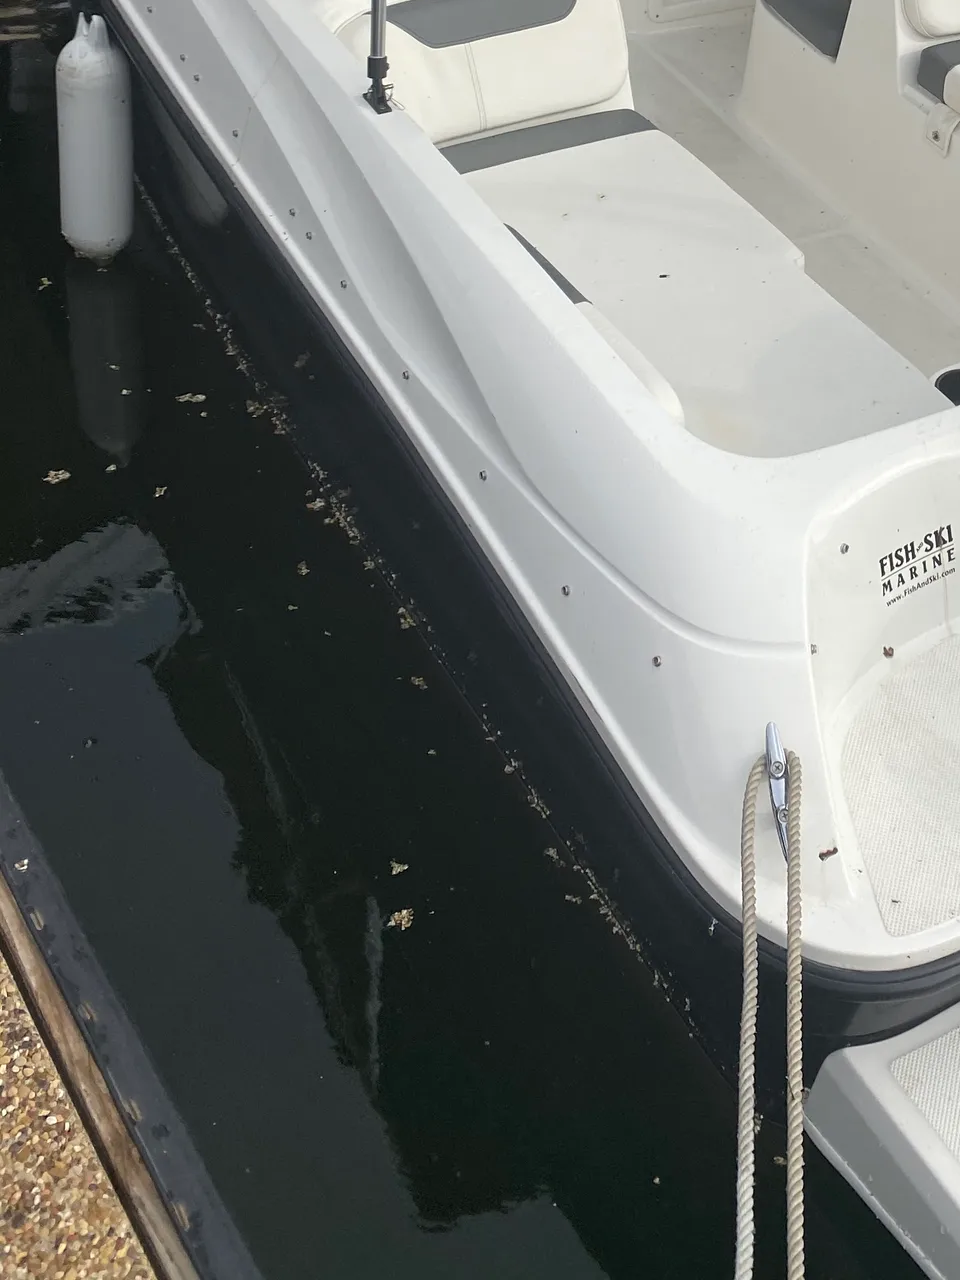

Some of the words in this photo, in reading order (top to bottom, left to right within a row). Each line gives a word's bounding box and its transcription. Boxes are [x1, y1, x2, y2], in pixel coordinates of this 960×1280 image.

[879, 541, 917, 577] FISH
[923, 524, 954, 553] SKI
[882, 547, 956, 597] MARINE
